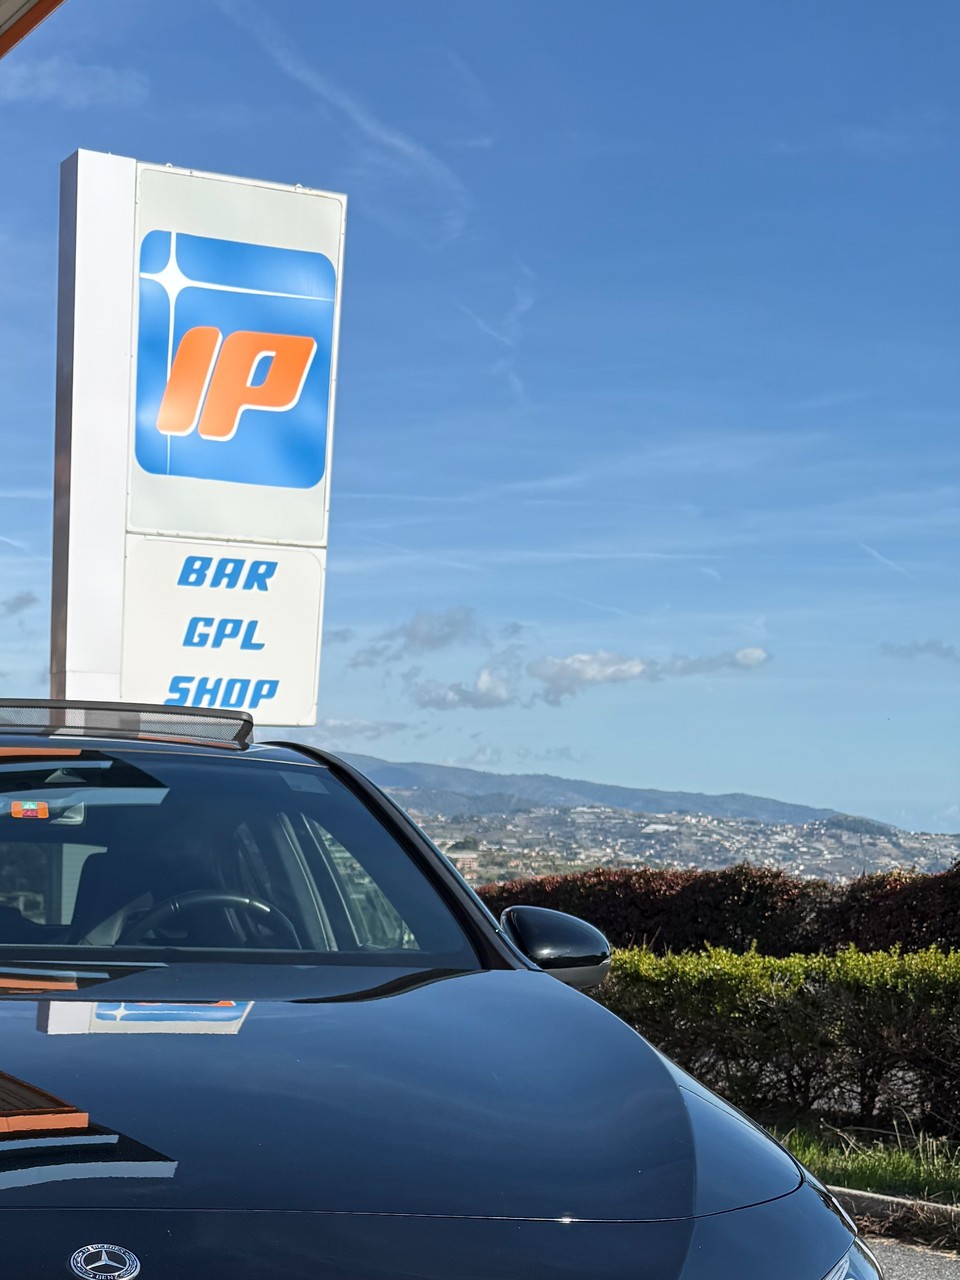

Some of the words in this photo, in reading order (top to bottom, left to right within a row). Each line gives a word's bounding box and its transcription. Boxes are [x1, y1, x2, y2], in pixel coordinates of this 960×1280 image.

[156, 325, 318, 442] IP
[177, 555, 279, 592] BAR
[182, 616, 265, 651] GPL
[163, 675, 280, 709] SHOP
